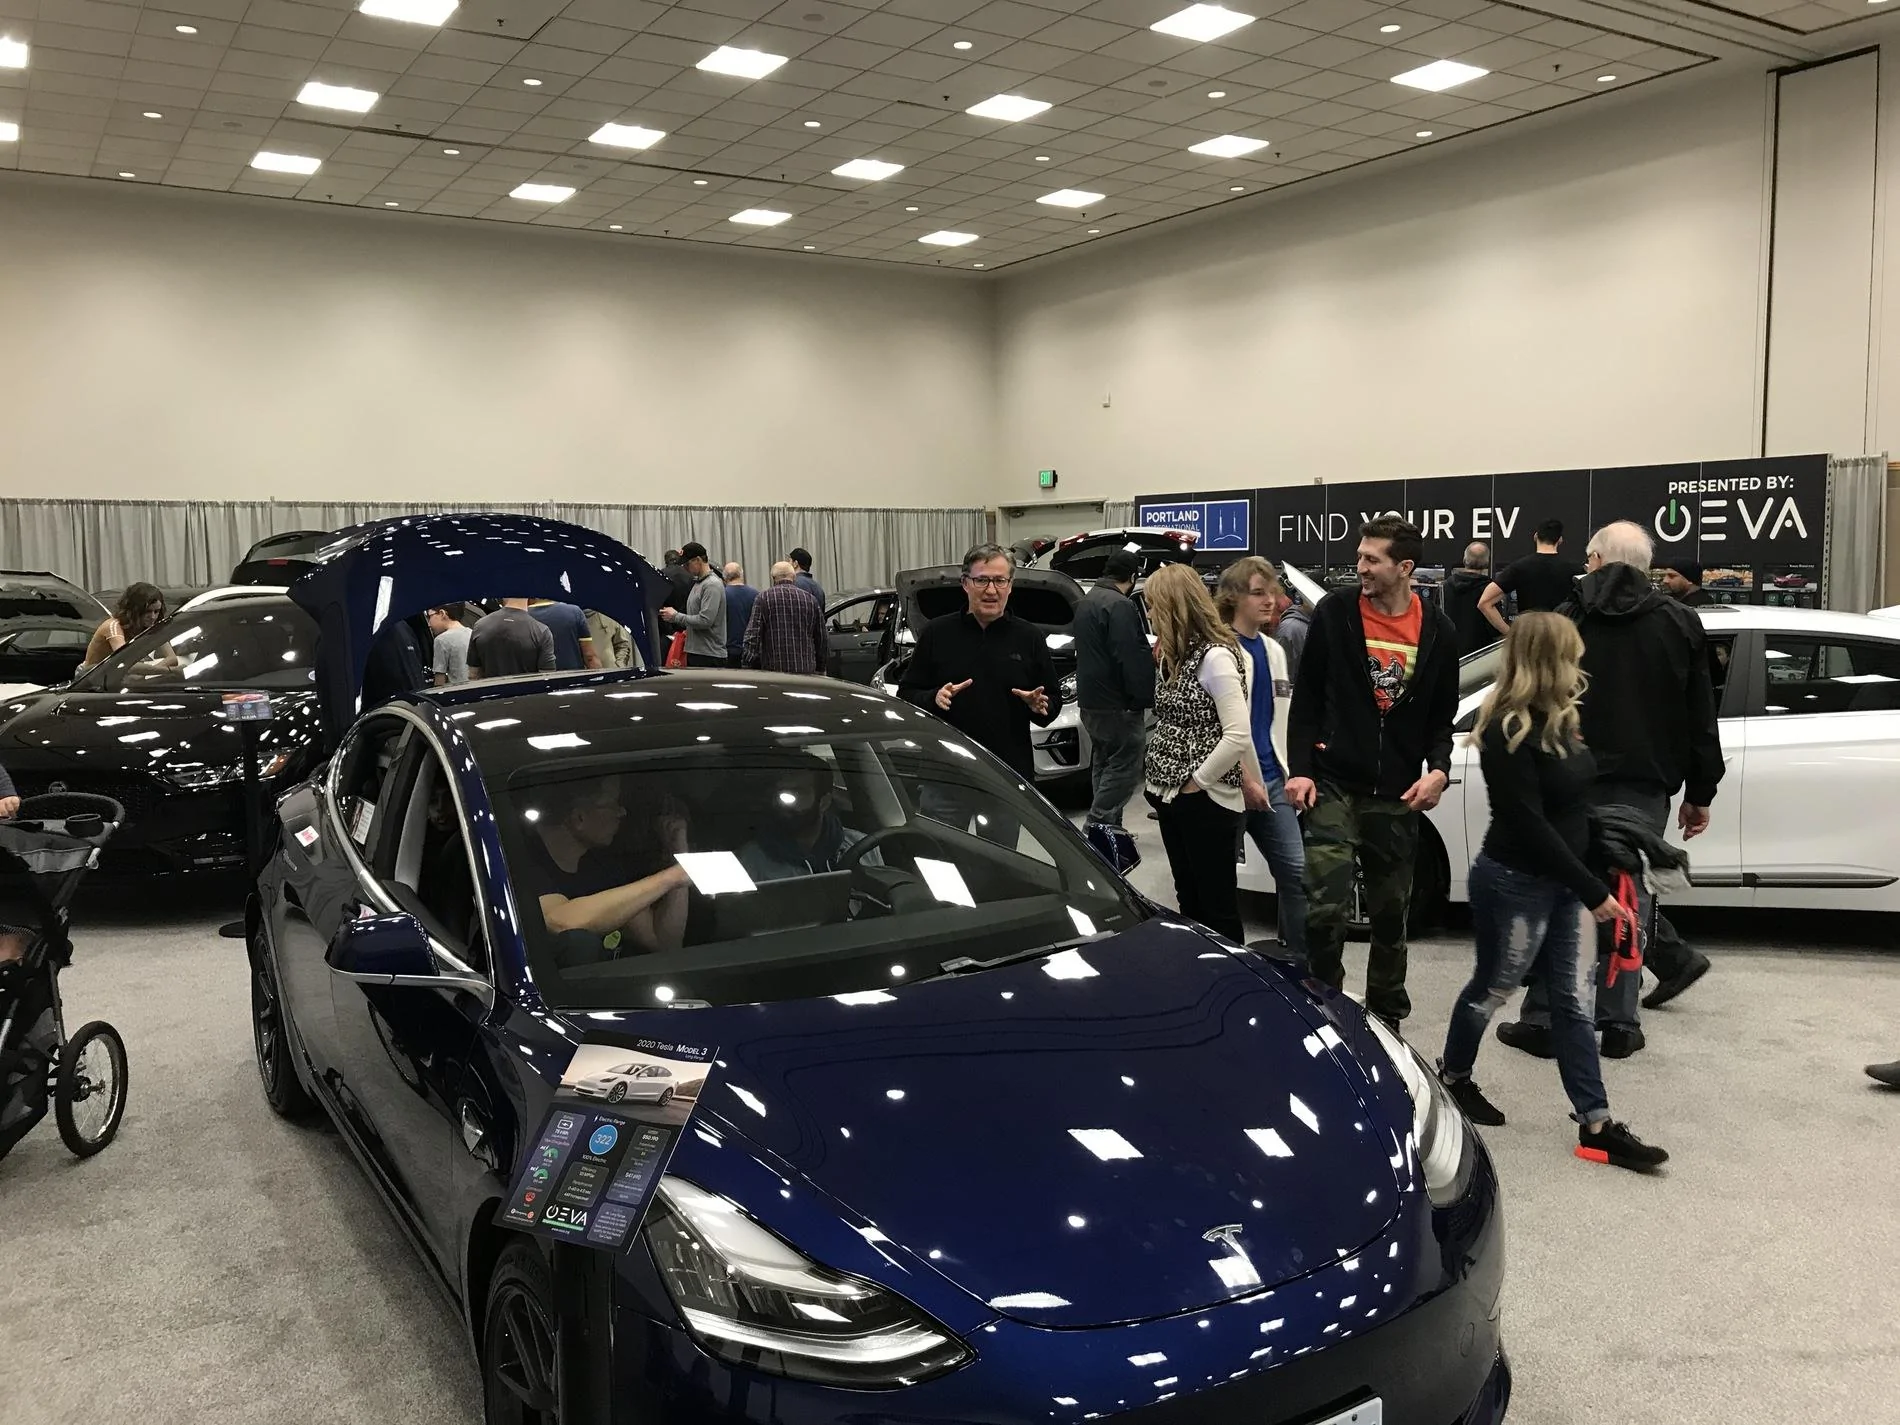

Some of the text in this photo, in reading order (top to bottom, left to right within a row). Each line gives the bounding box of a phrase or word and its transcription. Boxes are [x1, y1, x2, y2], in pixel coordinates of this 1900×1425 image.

[1668, 475, 1794, 494] PRESENTED BY:
[1146, 510, 1200, 523] PORTLAND
[1279, 506, 1520, 543] FIND UR EV
[637, 1039, 656, 1049] 2020
[656, 1041, 674, 1051] Tesla
[701, 1047, 708, 1056] 3
[595, 1134, 613, 1146] 322
